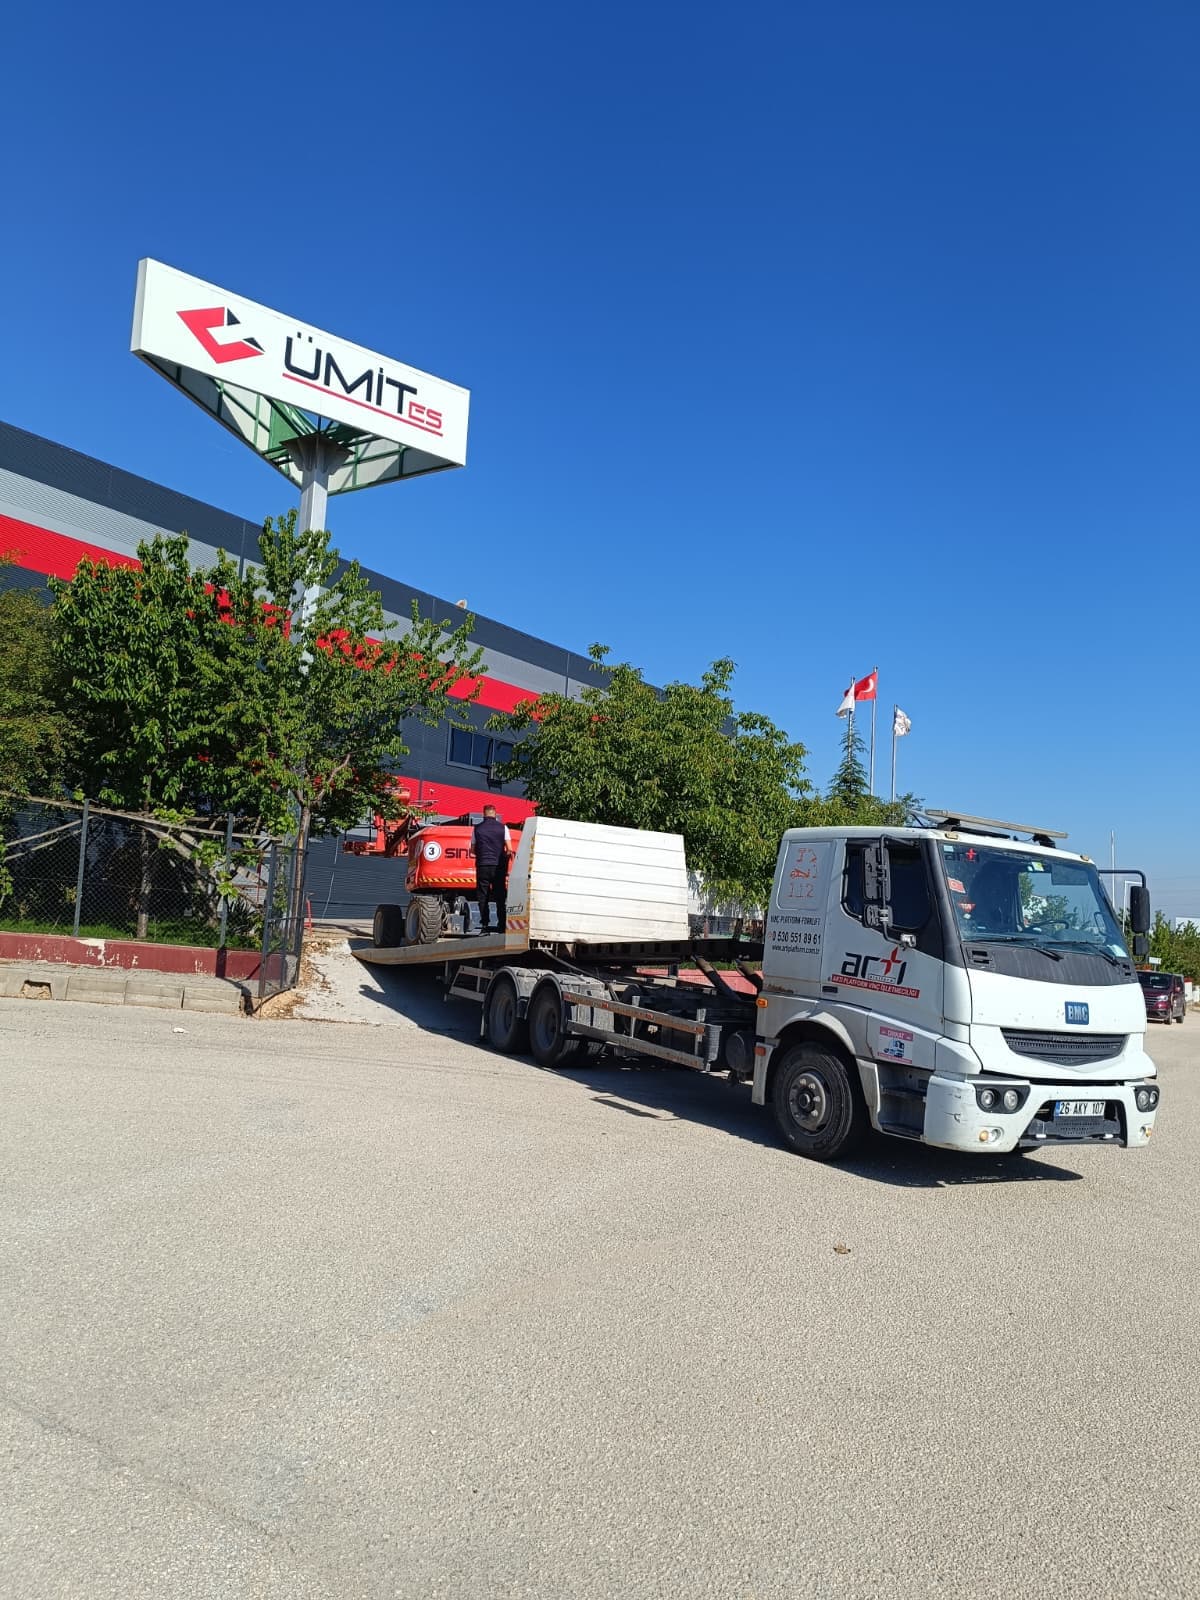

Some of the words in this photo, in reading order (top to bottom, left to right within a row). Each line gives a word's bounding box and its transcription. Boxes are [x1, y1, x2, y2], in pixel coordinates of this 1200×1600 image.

[428, 847, 435, 856] 3
[772, 931, 777, 941] 0
[790, 933, 802, 943] 551
[803, 933, 812, 944] 89
[812, 934, 821, 945] 61
[844, 977, 868, 988] PLATFORM
[1068, 1005, 1088, 1021] BMC
[1060, 1102, 1070, 1115] 26
[1073, 1102, 1089, 1115] AKY
[1092, 1102, 1105, 1115] 107
